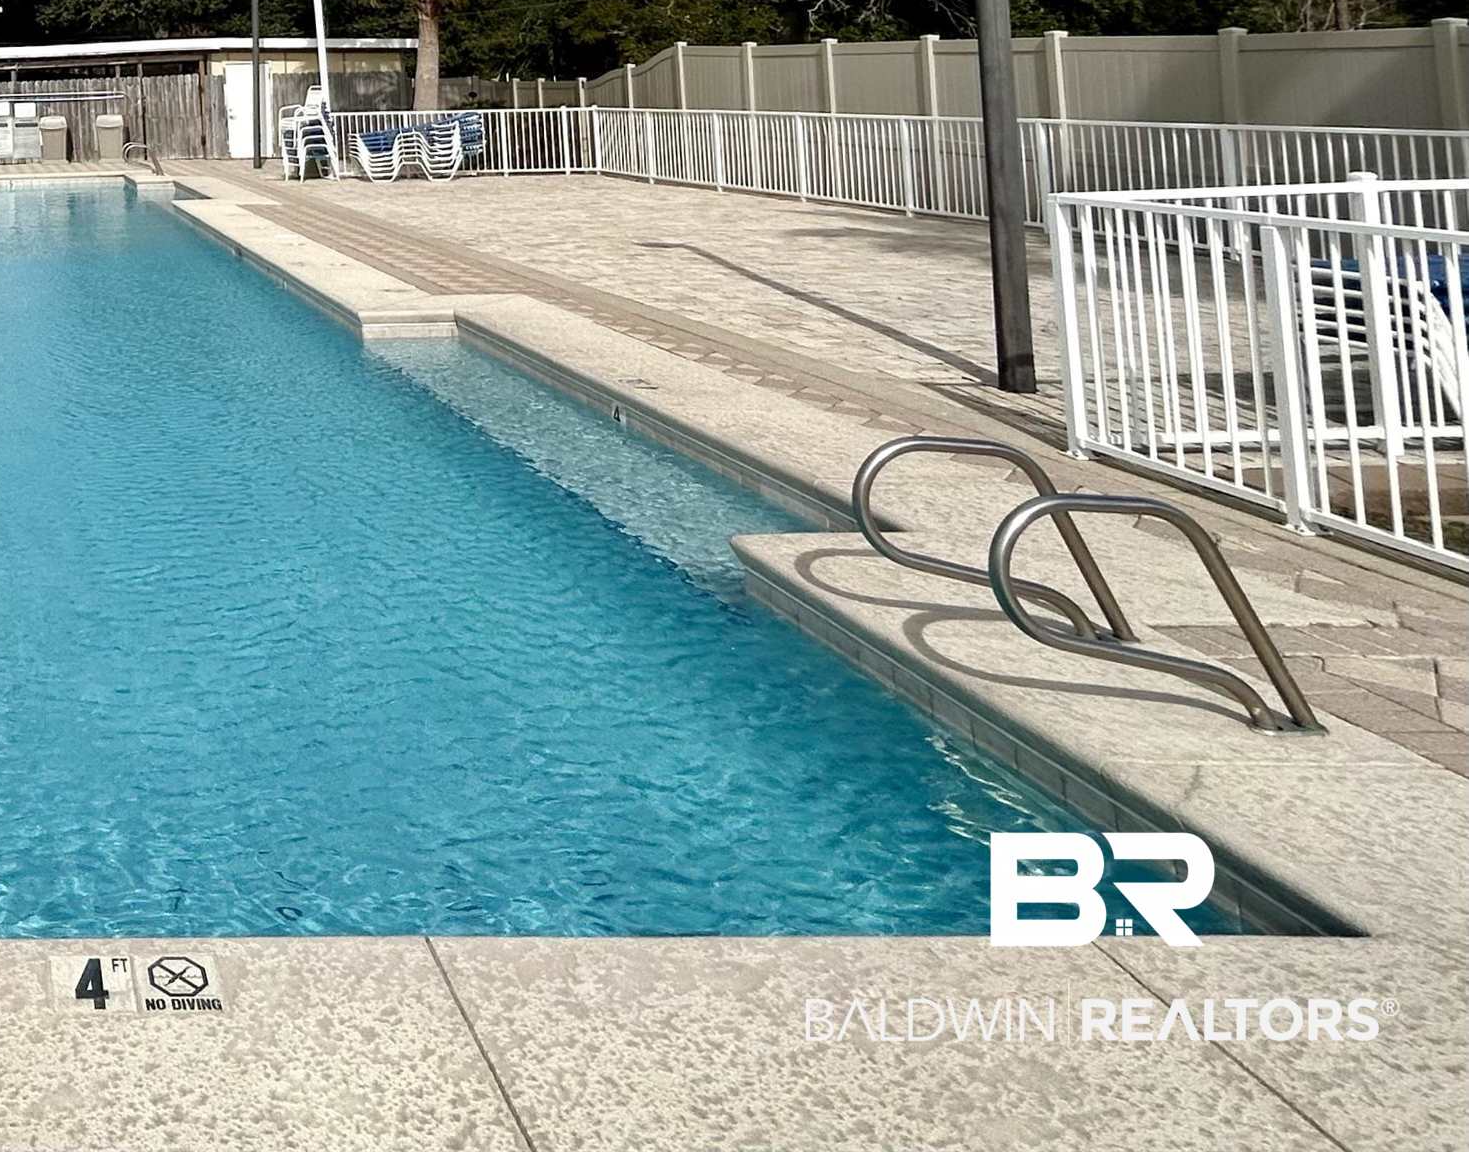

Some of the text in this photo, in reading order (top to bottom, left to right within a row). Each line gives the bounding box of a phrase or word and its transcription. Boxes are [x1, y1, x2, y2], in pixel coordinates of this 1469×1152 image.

[75, 958, 128, 1009] 4 FT
[145, 998, 222, 1010] NO DIVING
